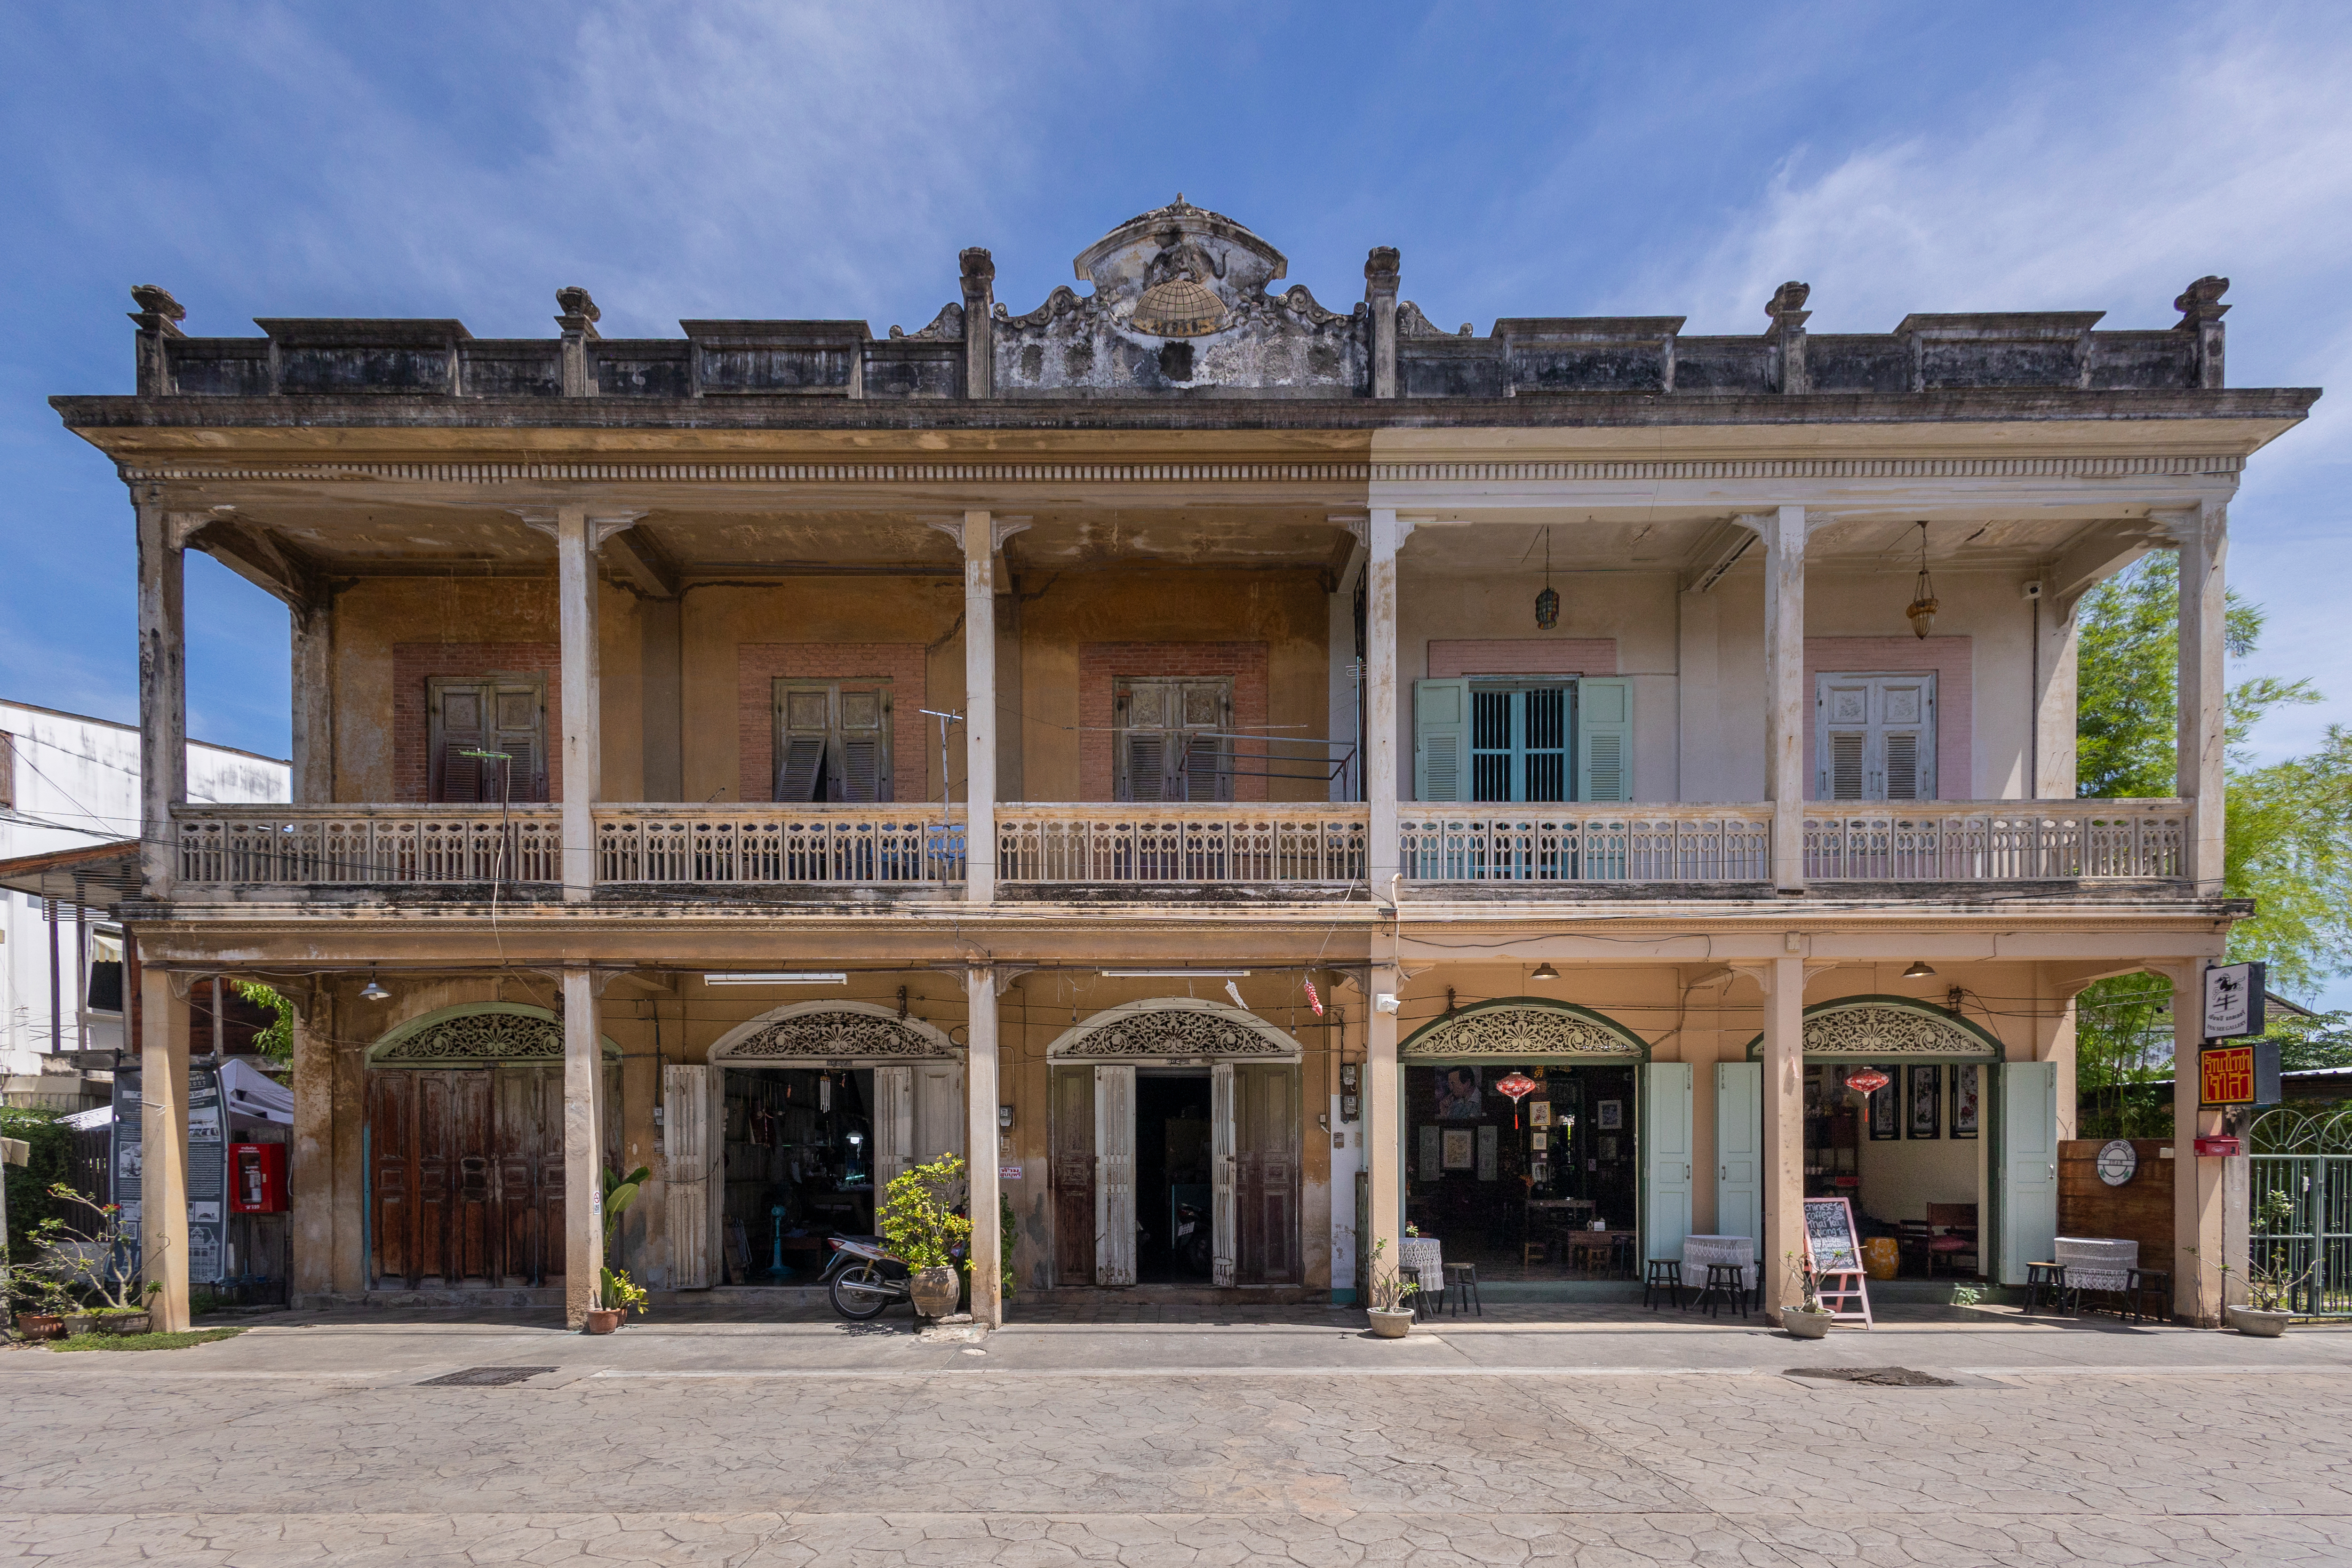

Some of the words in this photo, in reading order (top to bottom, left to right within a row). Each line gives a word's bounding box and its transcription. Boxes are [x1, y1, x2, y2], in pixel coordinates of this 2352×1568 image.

[2225, 1020, 2246, 1031] GALLERY
[1833, 1202, 1844, 1211] Tea
[1808, 1218, 1827, 1228] Thai
[1827, 1216, 1842, 1227] Tea
[1836, 1227, 1849, 1235] Tea
